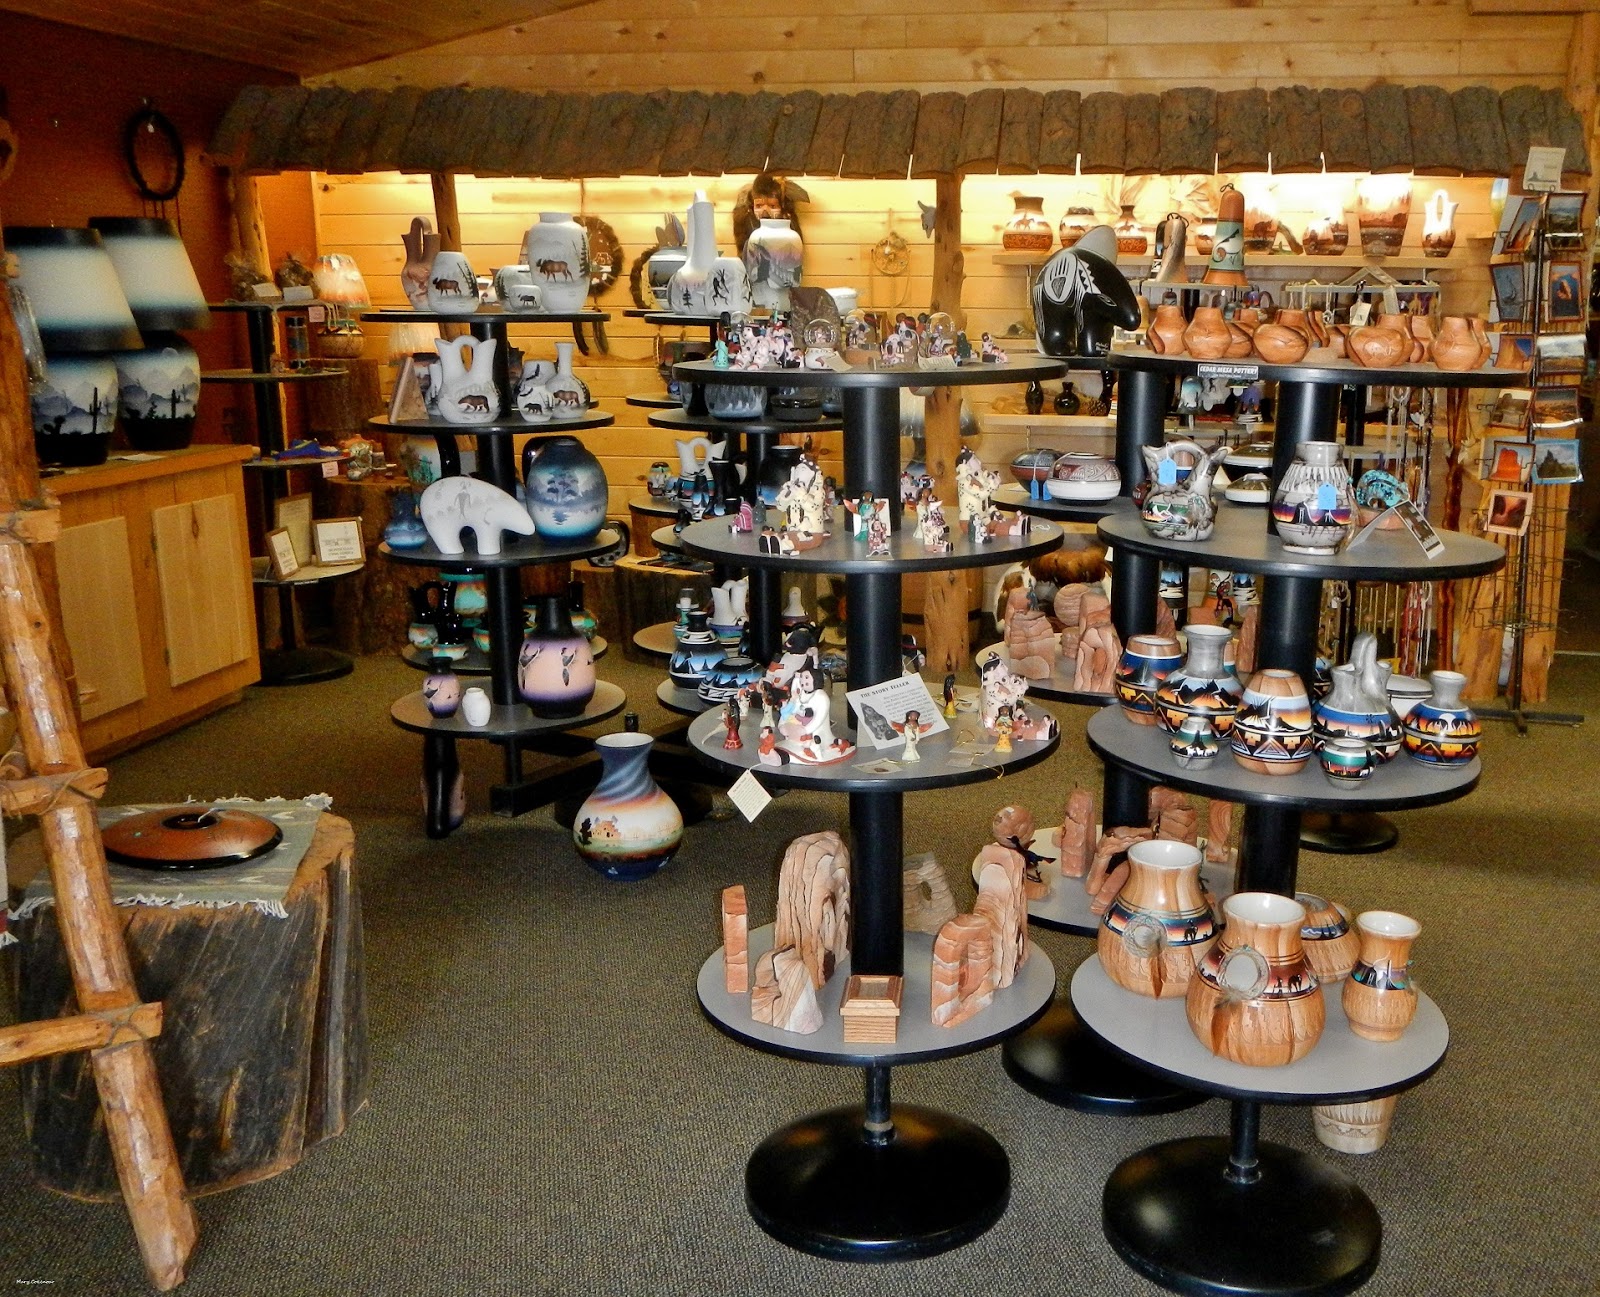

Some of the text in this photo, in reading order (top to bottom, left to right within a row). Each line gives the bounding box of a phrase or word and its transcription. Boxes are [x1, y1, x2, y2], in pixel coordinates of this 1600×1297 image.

[1199, 365, 1216, 373] CEDAR
[1217, 366, 1233, 374] MESA
[871, 686, 889, 696] STORY
[890, 681, 910, 690] TELLER
